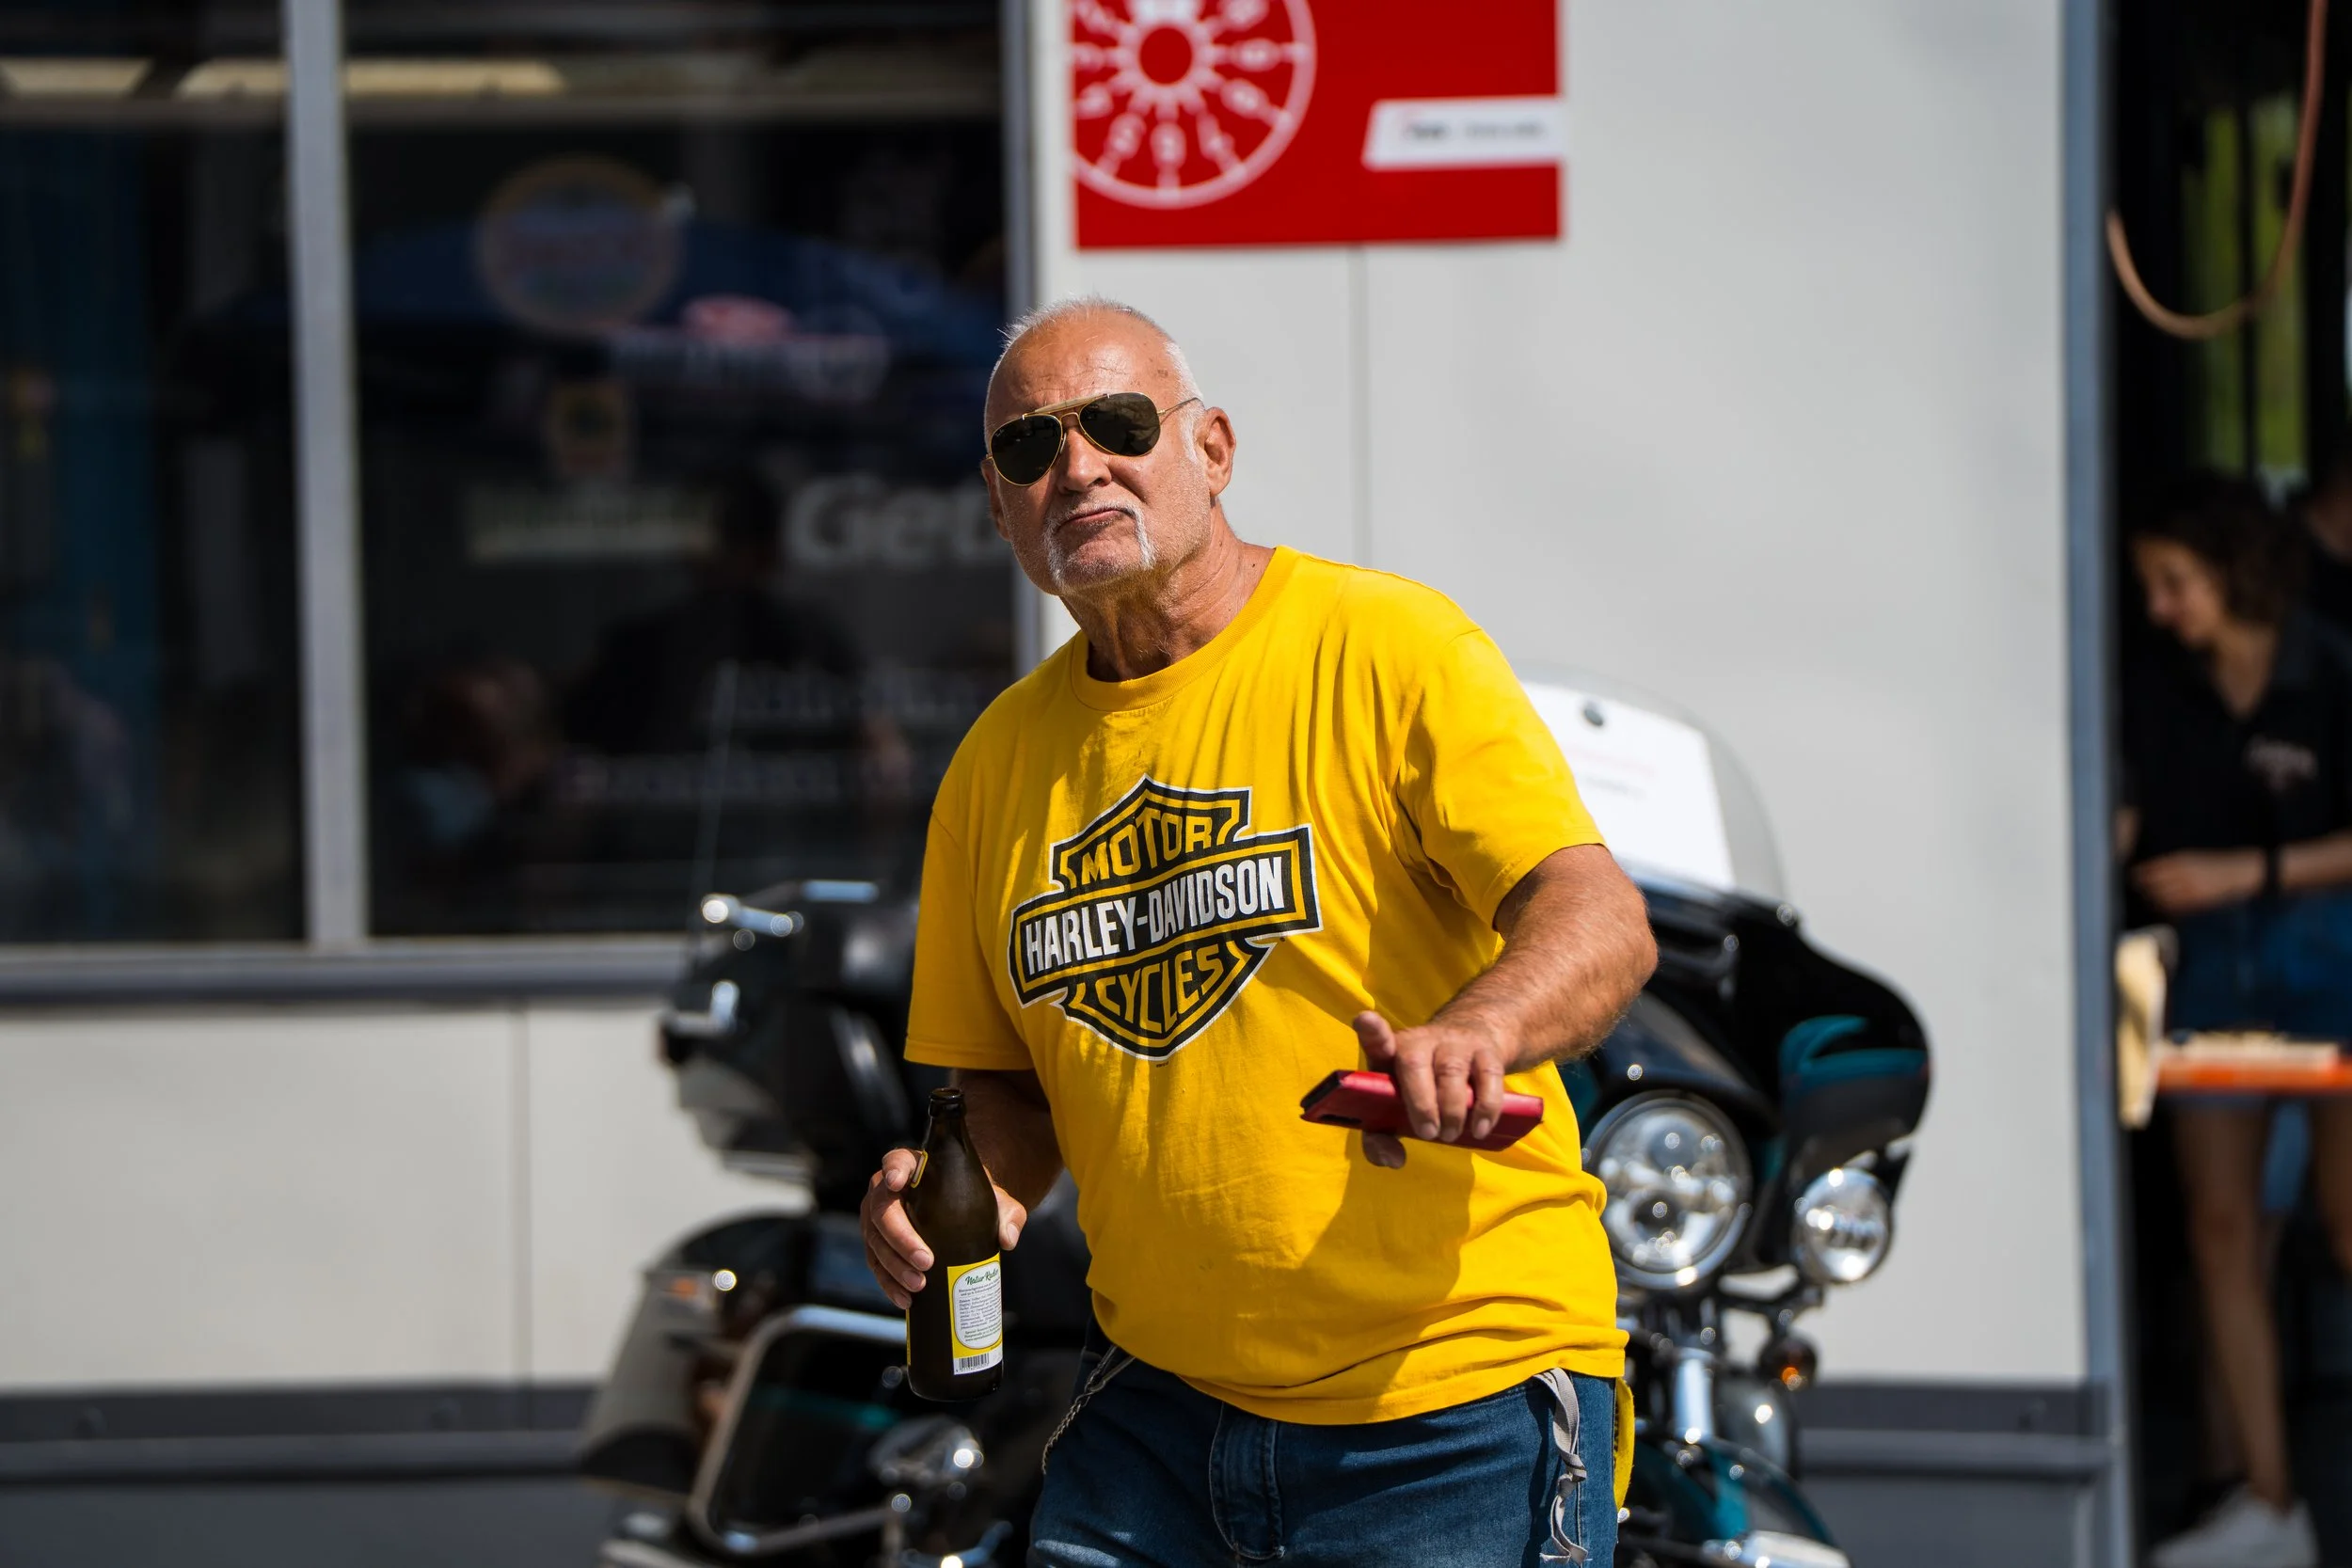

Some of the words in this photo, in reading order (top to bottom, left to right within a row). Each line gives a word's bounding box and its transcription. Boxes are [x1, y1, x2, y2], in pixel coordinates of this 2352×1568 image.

[1082, 807, 1213, 884] MOTOR
[1025, 856, 1285, 975] HARLEY-DAVIDSON
[1096, 943, 1224, 1034] CYCLES
[964, 1275, 985, 1286] Natur
